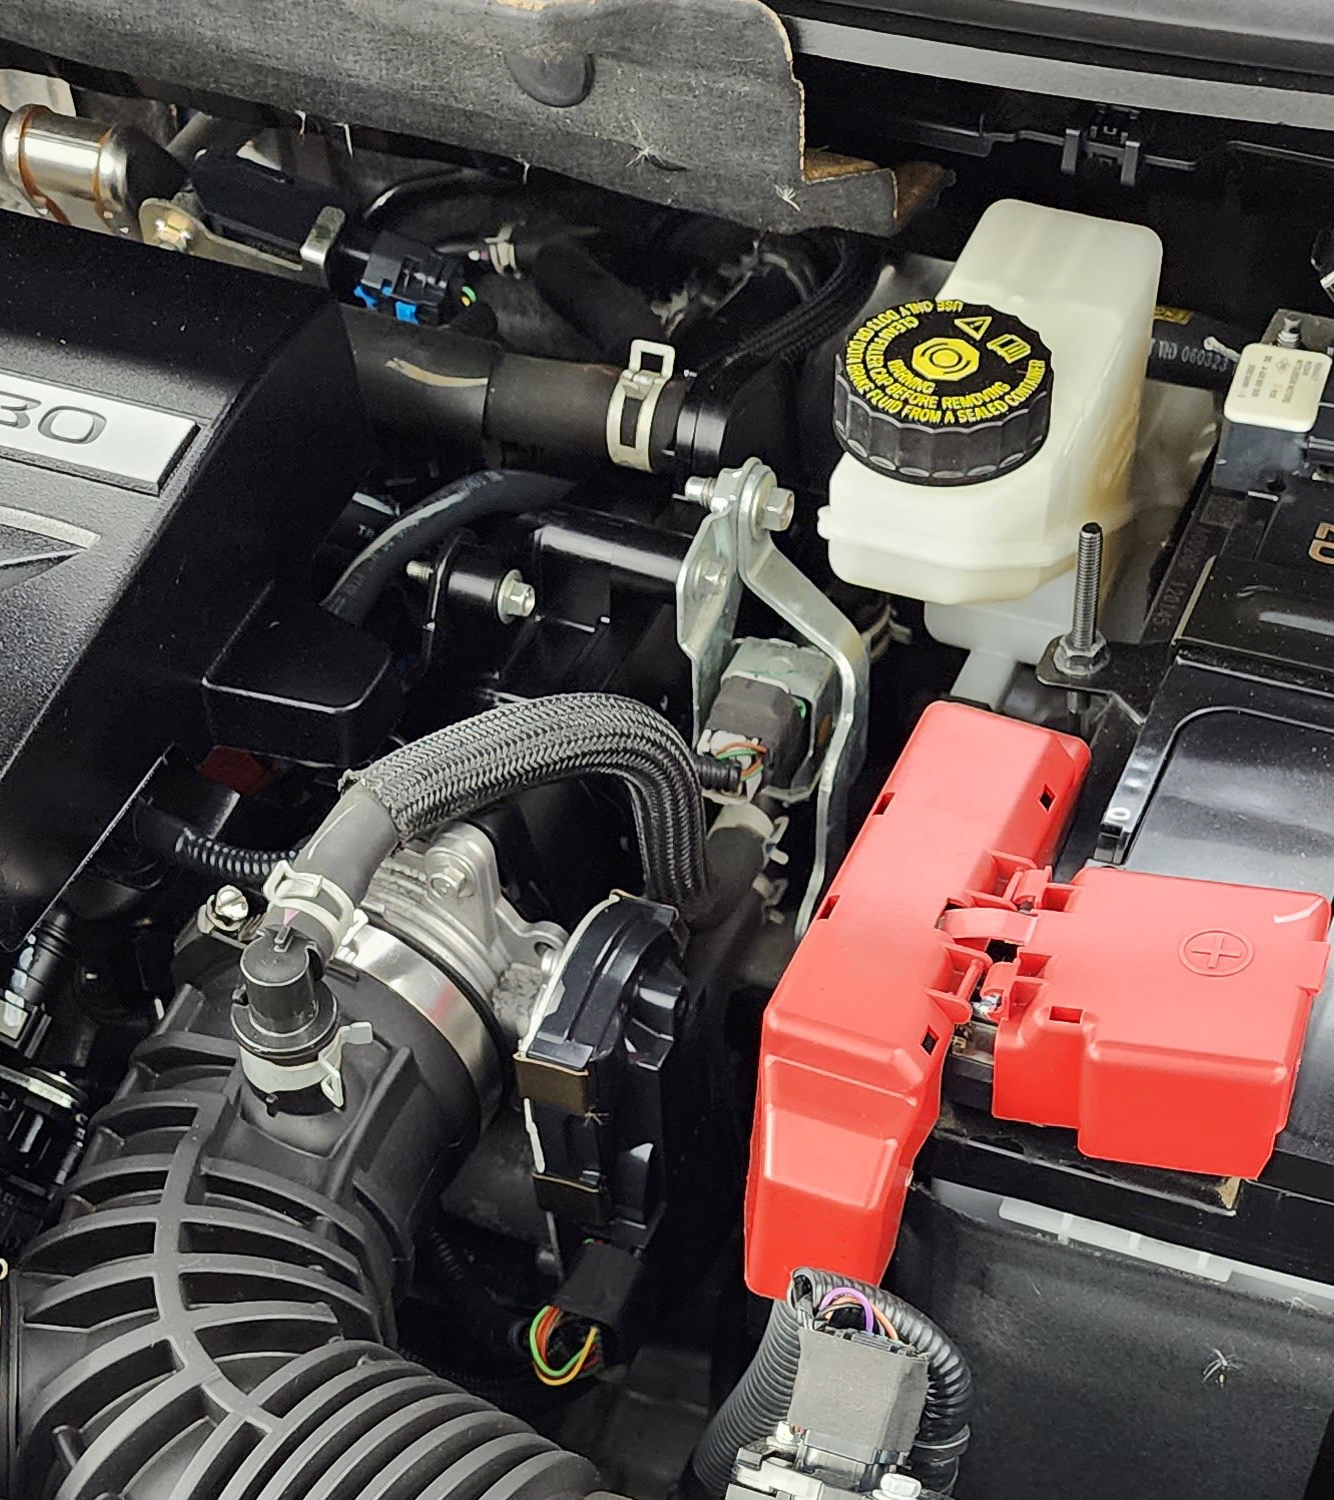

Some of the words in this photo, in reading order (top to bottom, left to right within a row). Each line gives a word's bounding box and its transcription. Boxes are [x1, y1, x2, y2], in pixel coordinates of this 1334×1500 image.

[898, 300, 933, 319] ONLY
[846, 363, 875, 391] BRAKE
[869, 367, 894, 386] CAP
[885, 380, 938, 410] BEFORE
[941, 381, 1010, 411] REMOVING
[887, 358, 935, 396] WARNING
[1004, 359, 1045, 405] CONTAINER
[867, 388, 903, 412] FLUID
[956, 399, 1008, 422] SEALED
[901, 404, 942, 422] FROM
[944, 410, 954, 422] A
